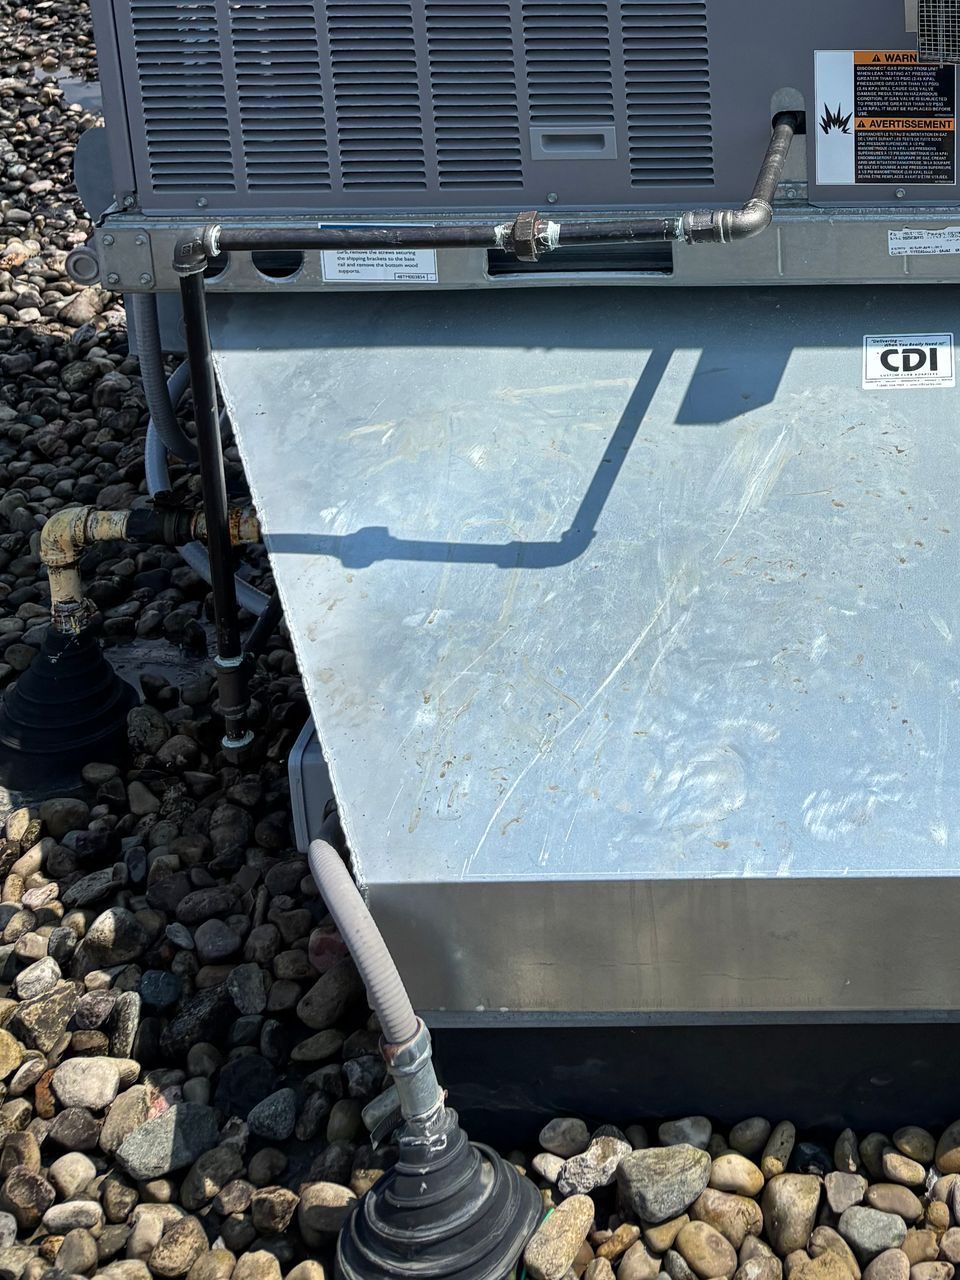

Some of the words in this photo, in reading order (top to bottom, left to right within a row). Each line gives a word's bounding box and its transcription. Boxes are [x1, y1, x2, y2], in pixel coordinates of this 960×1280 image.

[885, 54, 917, 62] WARN
[869, 120, 952, 128] AVERTISSEMENT
[880, 348, 938, 372] CDI
